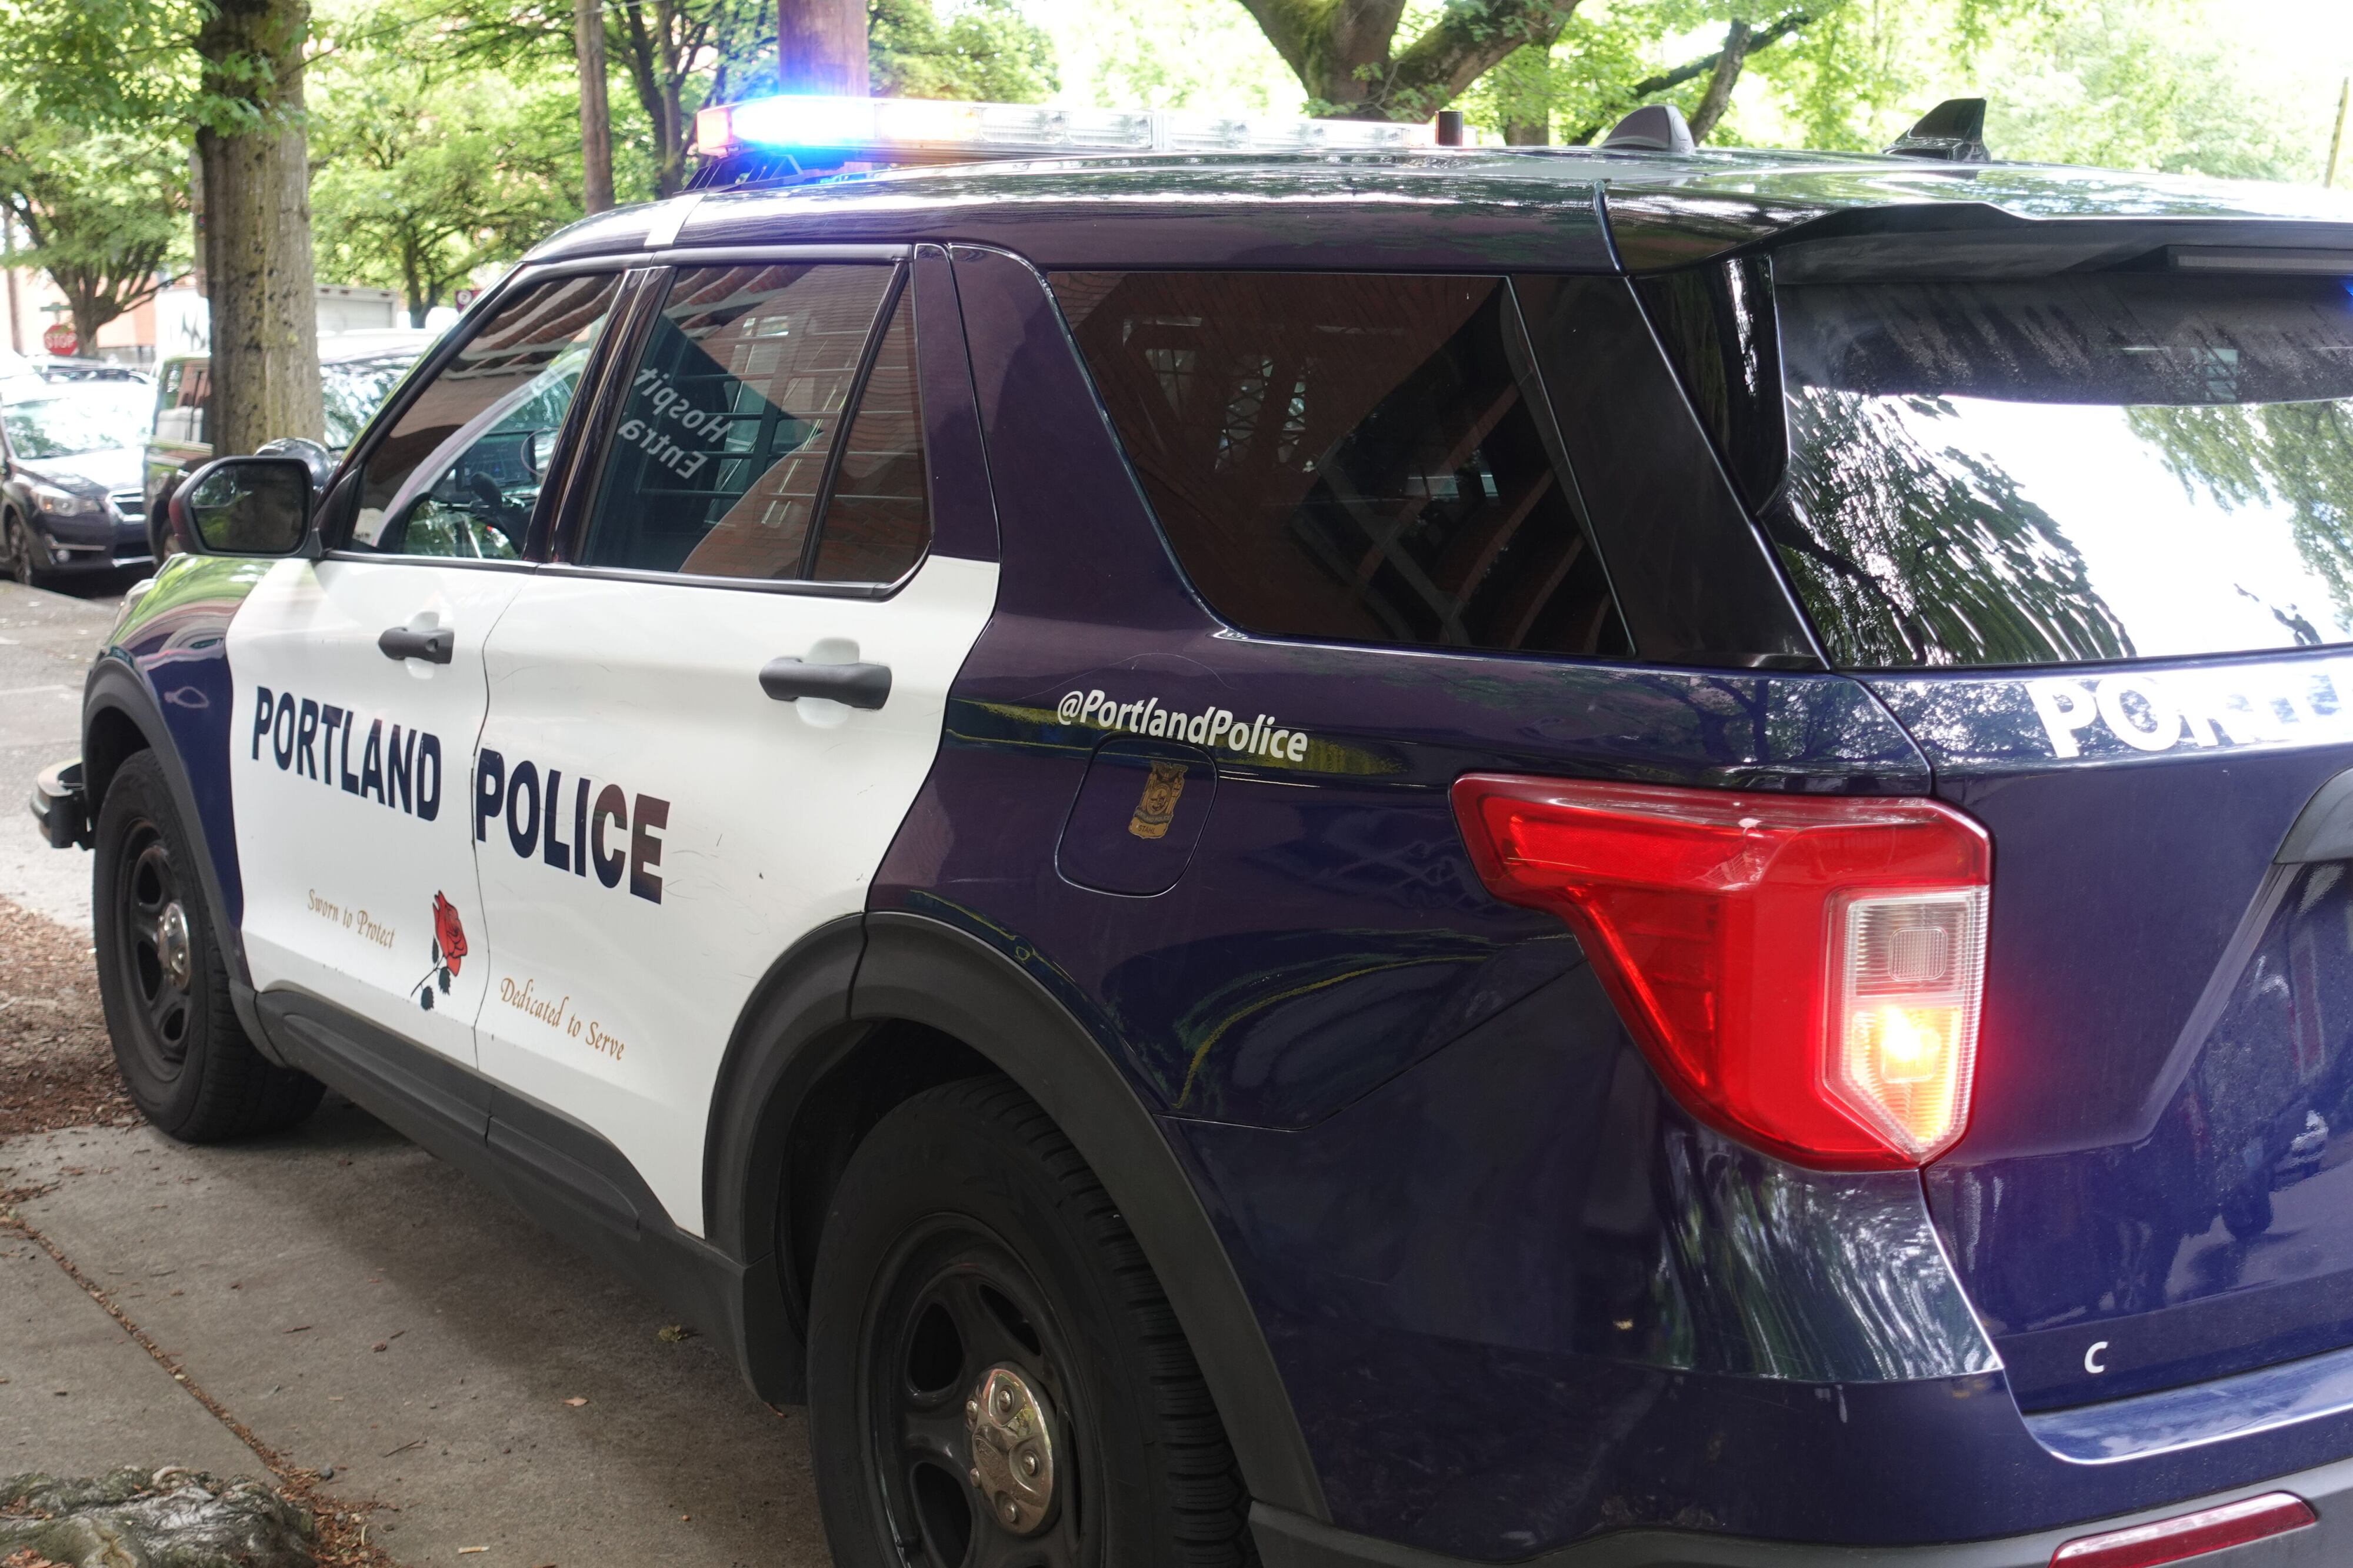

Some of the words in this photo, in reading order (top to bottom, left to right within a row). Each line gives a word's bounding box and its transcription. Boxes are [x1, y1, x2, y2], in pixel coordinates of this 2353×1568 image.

[1057, 689, 1308, 762] @PortlandPolice
[252, 686, 441, 822] PORTLAND
[475, 748, 671, 905] POLICE
[308, 889, 339, 922] Sworn
[342, 907, 353, 929] to
[357, 910, 395, 948] Protect
[501, 978, 569, 1028] Dedicated
[568, 1013, 581, 1037] to
[586, 1022, 624, 1060] Serve
[2084, 1342, 2108, 1373] C
